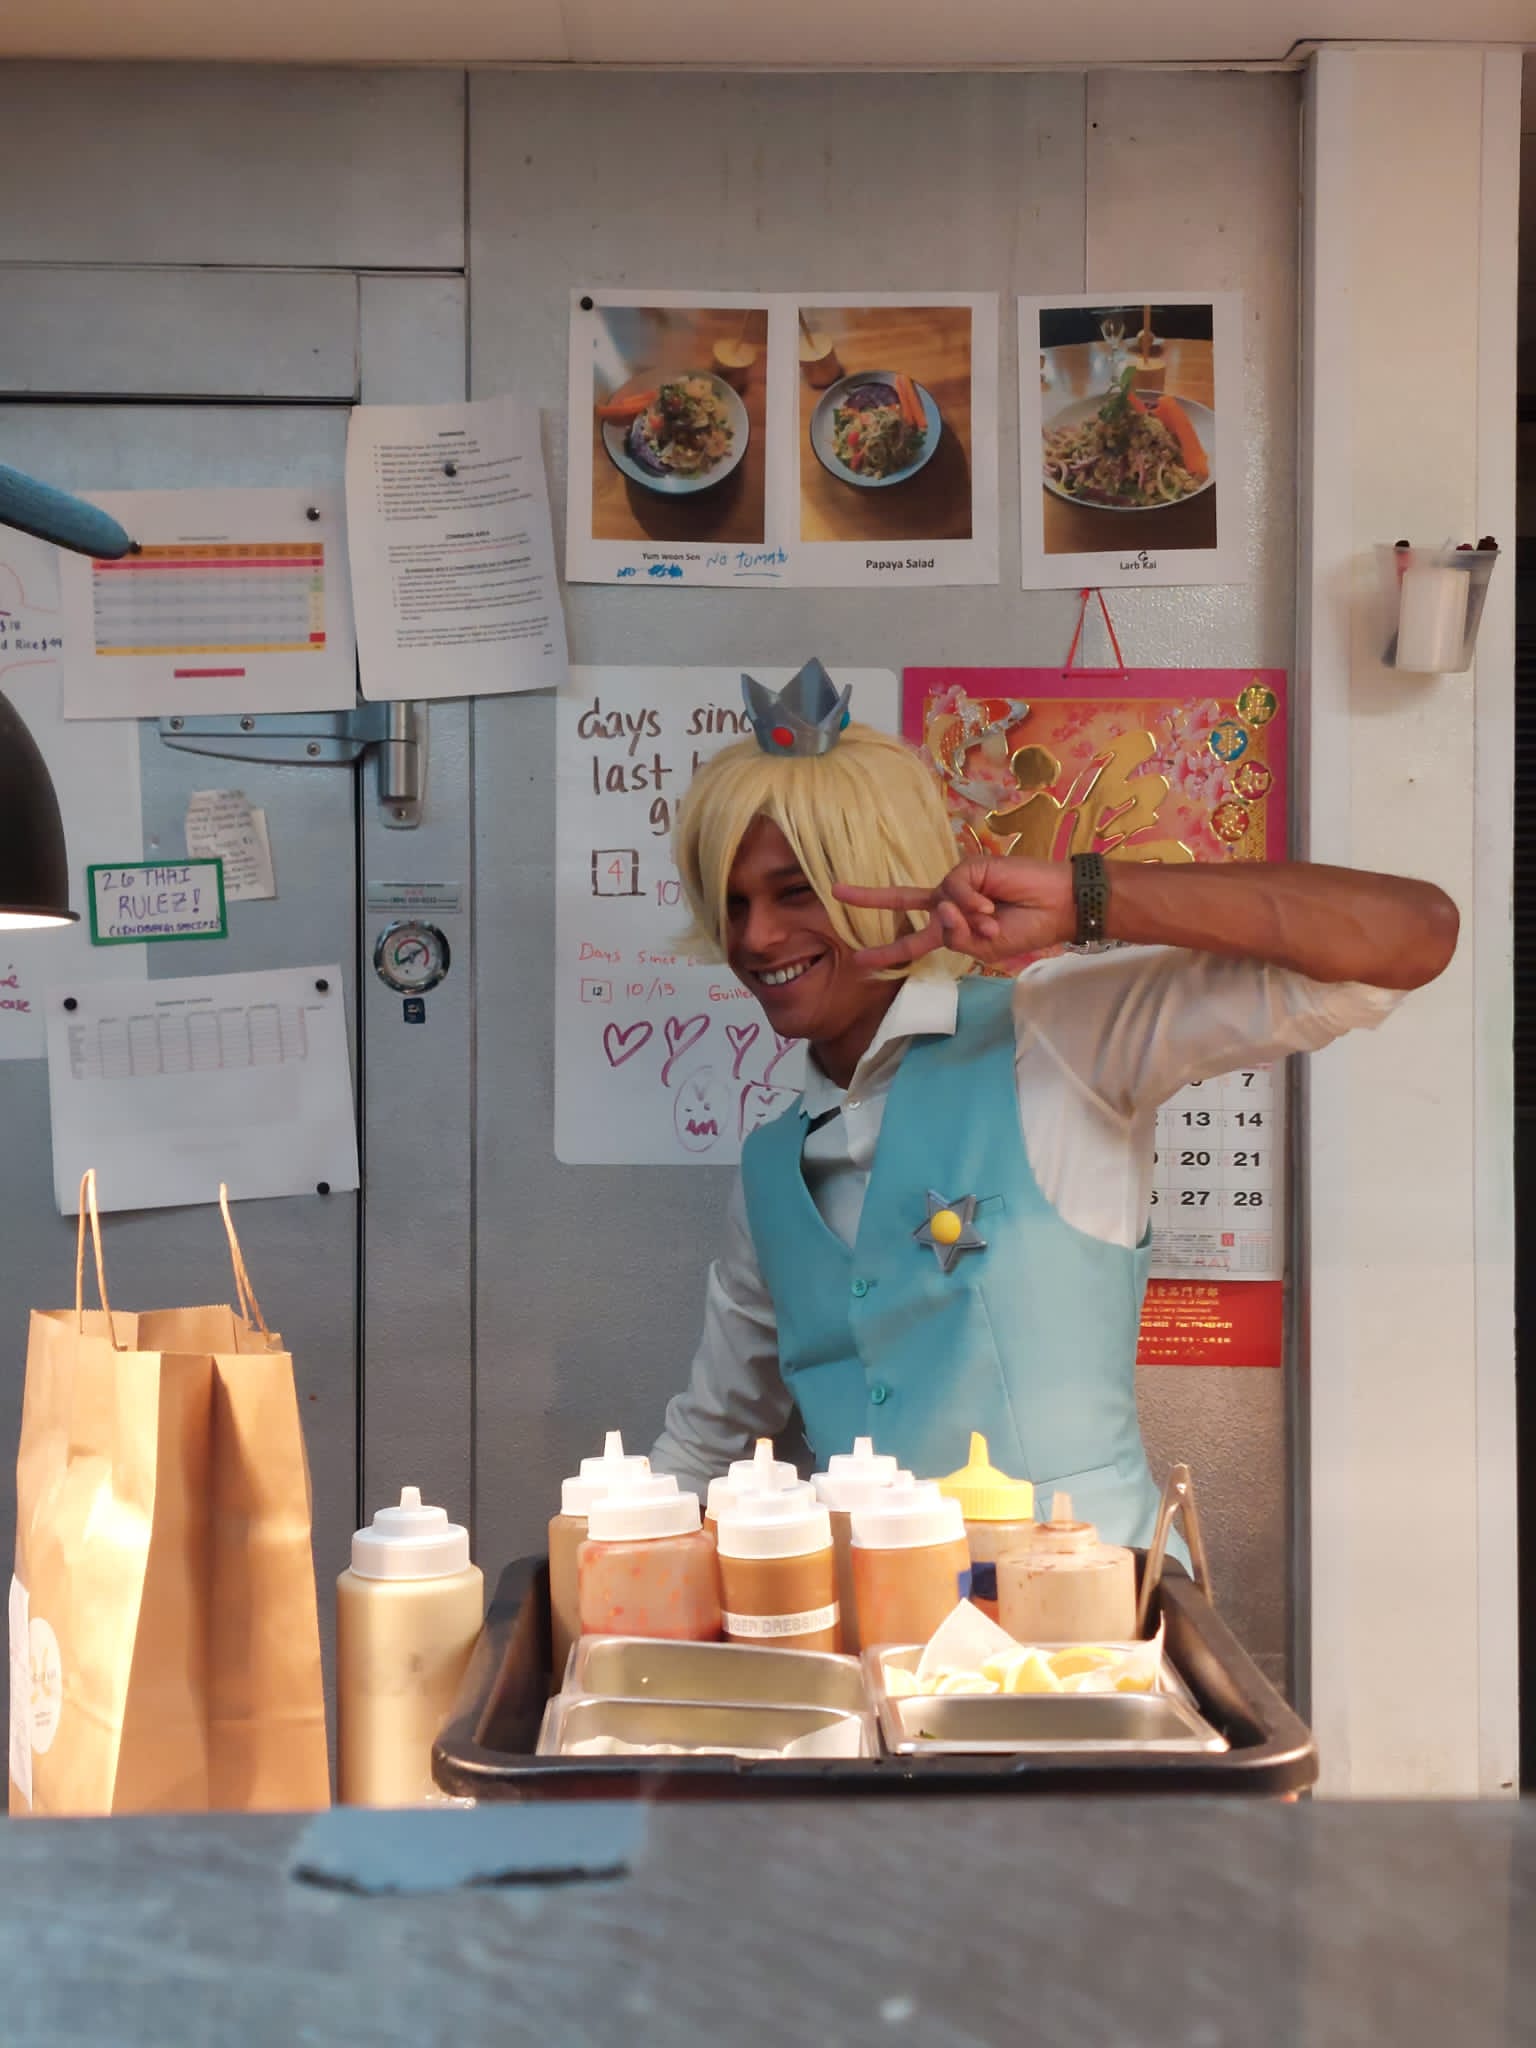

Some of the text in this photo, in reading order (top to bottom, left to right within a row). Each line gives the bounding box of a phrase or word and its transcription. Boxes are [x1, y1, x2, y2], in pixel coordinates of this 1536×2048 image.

[865, 558, 935, 571] Papaya Salad
[1119, 560, 1140, 570] Larb
[577, 697, 753, 757] days sinc
[593, 753, 673, 795] last
[143, 867, 192, 887] THAI
[608, 859, 624, 886] 4
[118, 888, 201, 919] RULEZ!
[578, 942, 621, 967] Days
[1241, 1072, 1255, 1087] 7
[1181, 1111, 1263, 1127] 13 14
[1181, 1151, 1260, 1167] 20 21
[1181, 1190, 1210, 1206] 27
[1233, 1191, 1263, 1207] 28
